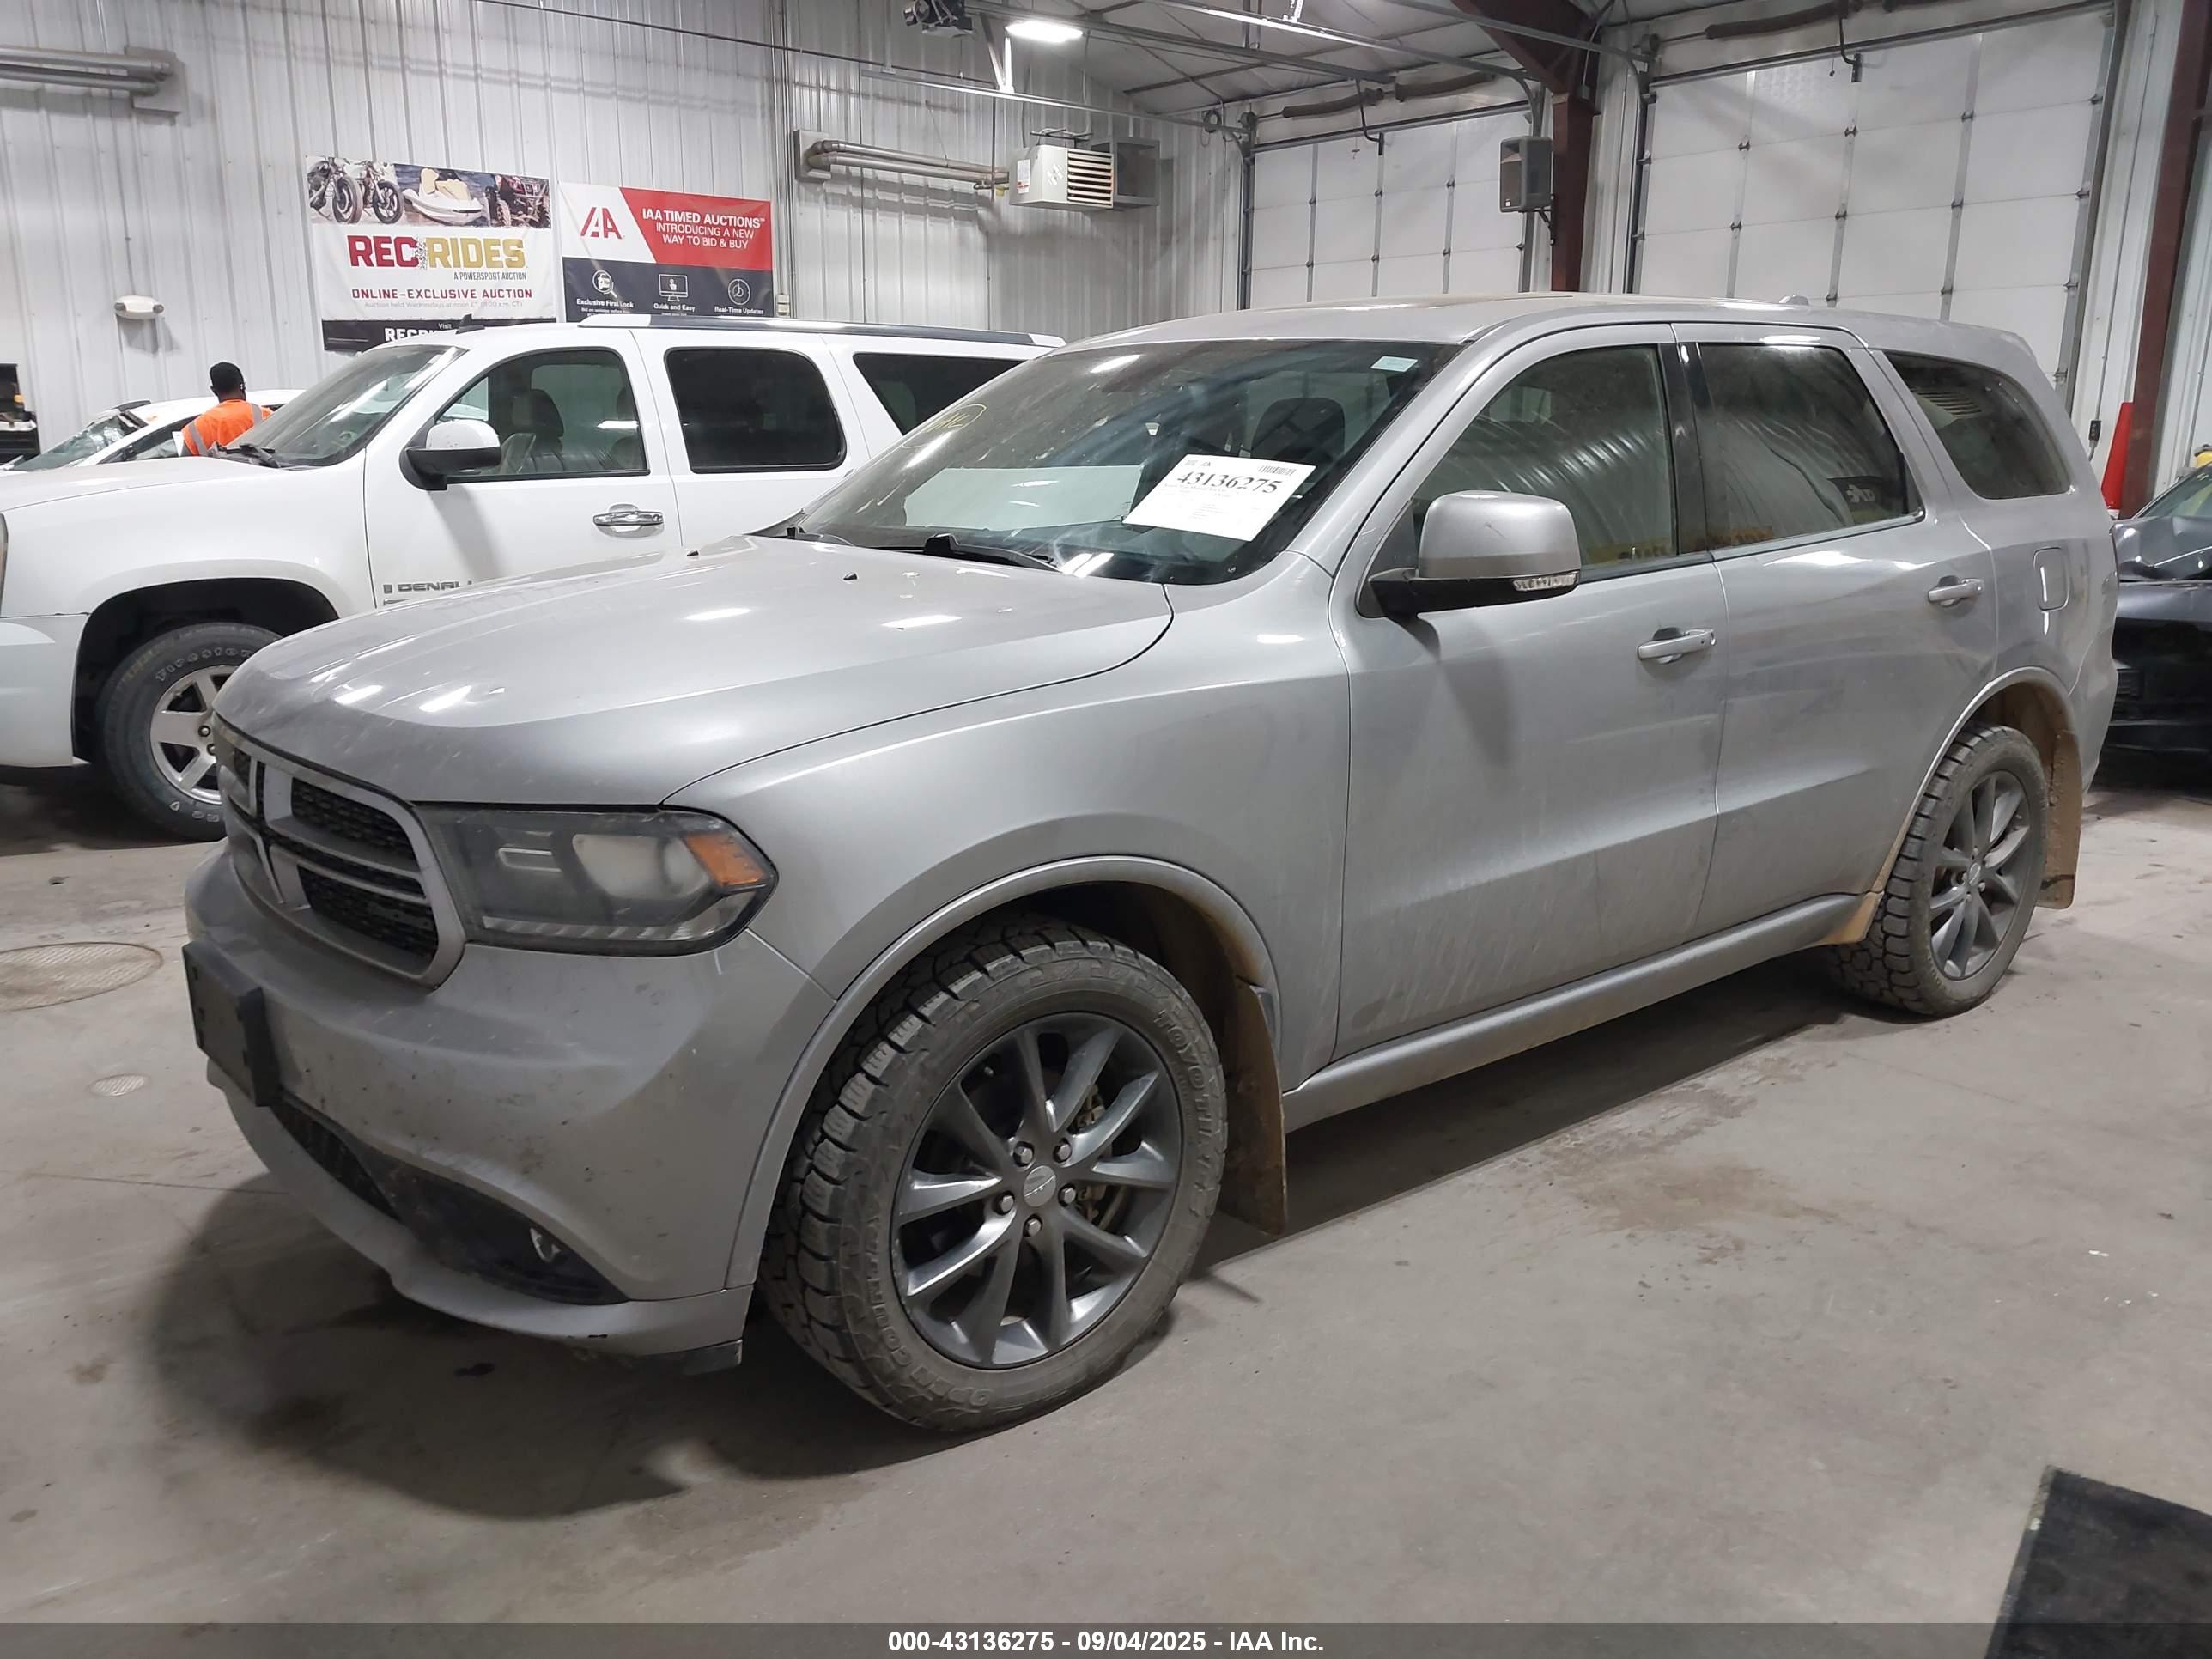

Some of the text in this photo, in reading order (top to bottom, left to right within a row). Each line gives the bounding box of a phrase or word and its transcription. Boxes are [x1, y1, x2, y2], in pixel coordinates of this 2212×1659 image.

[642, 208, 663, 221] IAA
[664, 210, 702, 223] TIMED
[656, 222, 755, 240] INTRODUCING A NEW
[662, 234, 749, 249] WAY TO BID & BUY
[346, 234, 526, 270] REC RIDES
[453, 271, 526, 281] A POWERSPORT AUCTION
[352, 288, 533, 300] ONLINE-EXCLUSIVE AUCTION
[576, 298, 605, 307] Exclusive
[1176, 471, 1283, 495] 43136275
